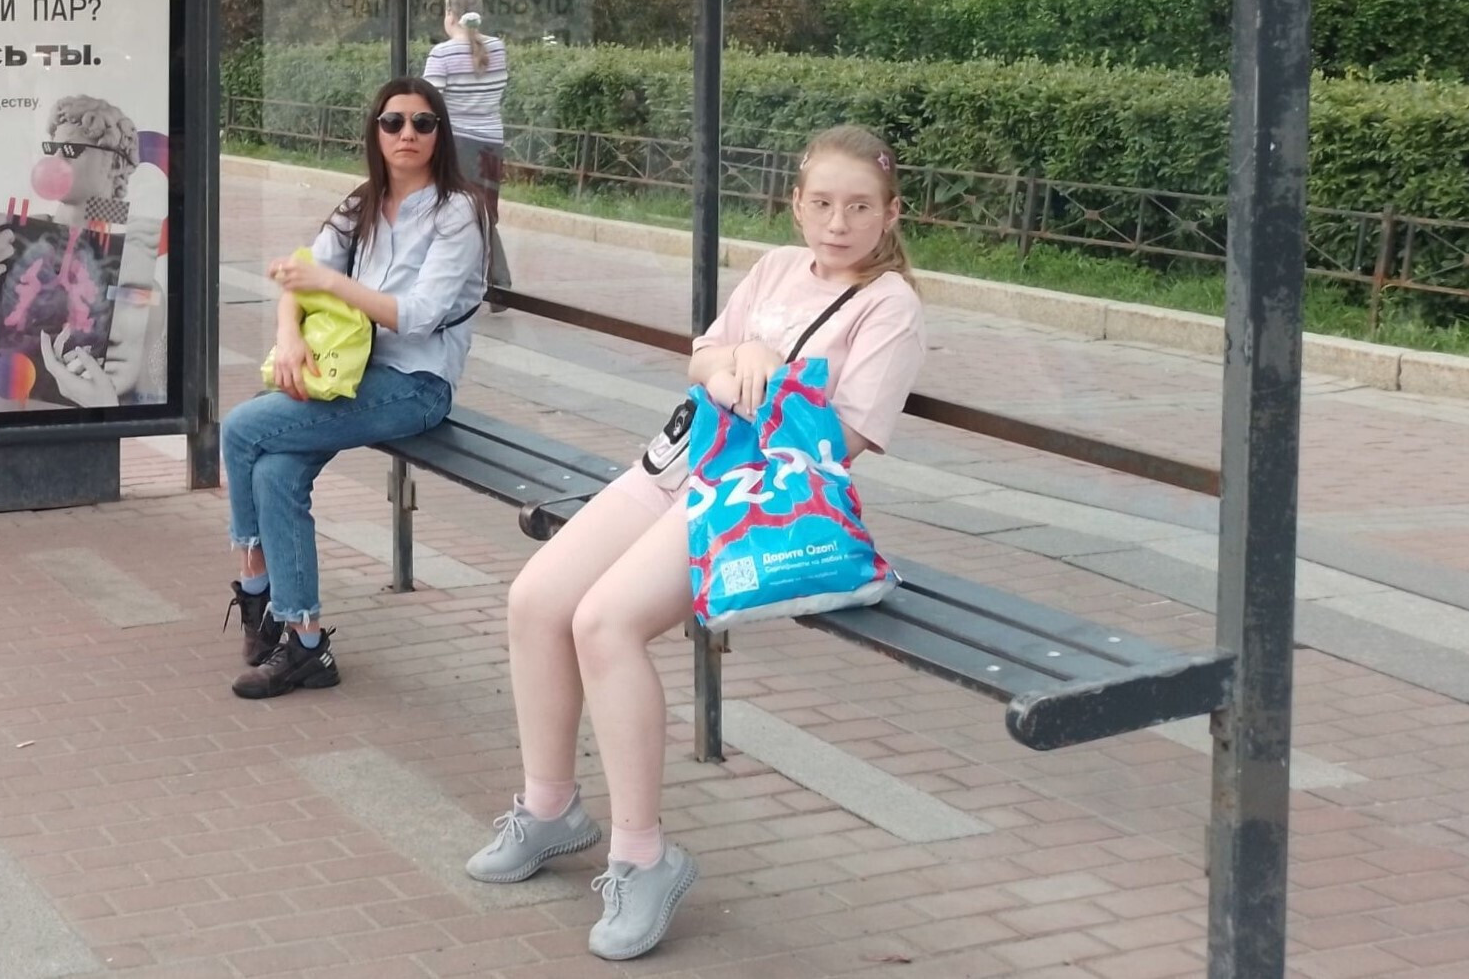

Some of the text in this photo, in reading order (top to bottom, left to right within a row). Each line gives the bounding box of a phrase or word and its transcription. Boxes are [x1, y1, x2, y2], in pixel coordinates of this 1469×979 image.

[34, 44, 102, 67] ты.
[762, 540, 838, 565] Дарите Ozon!
